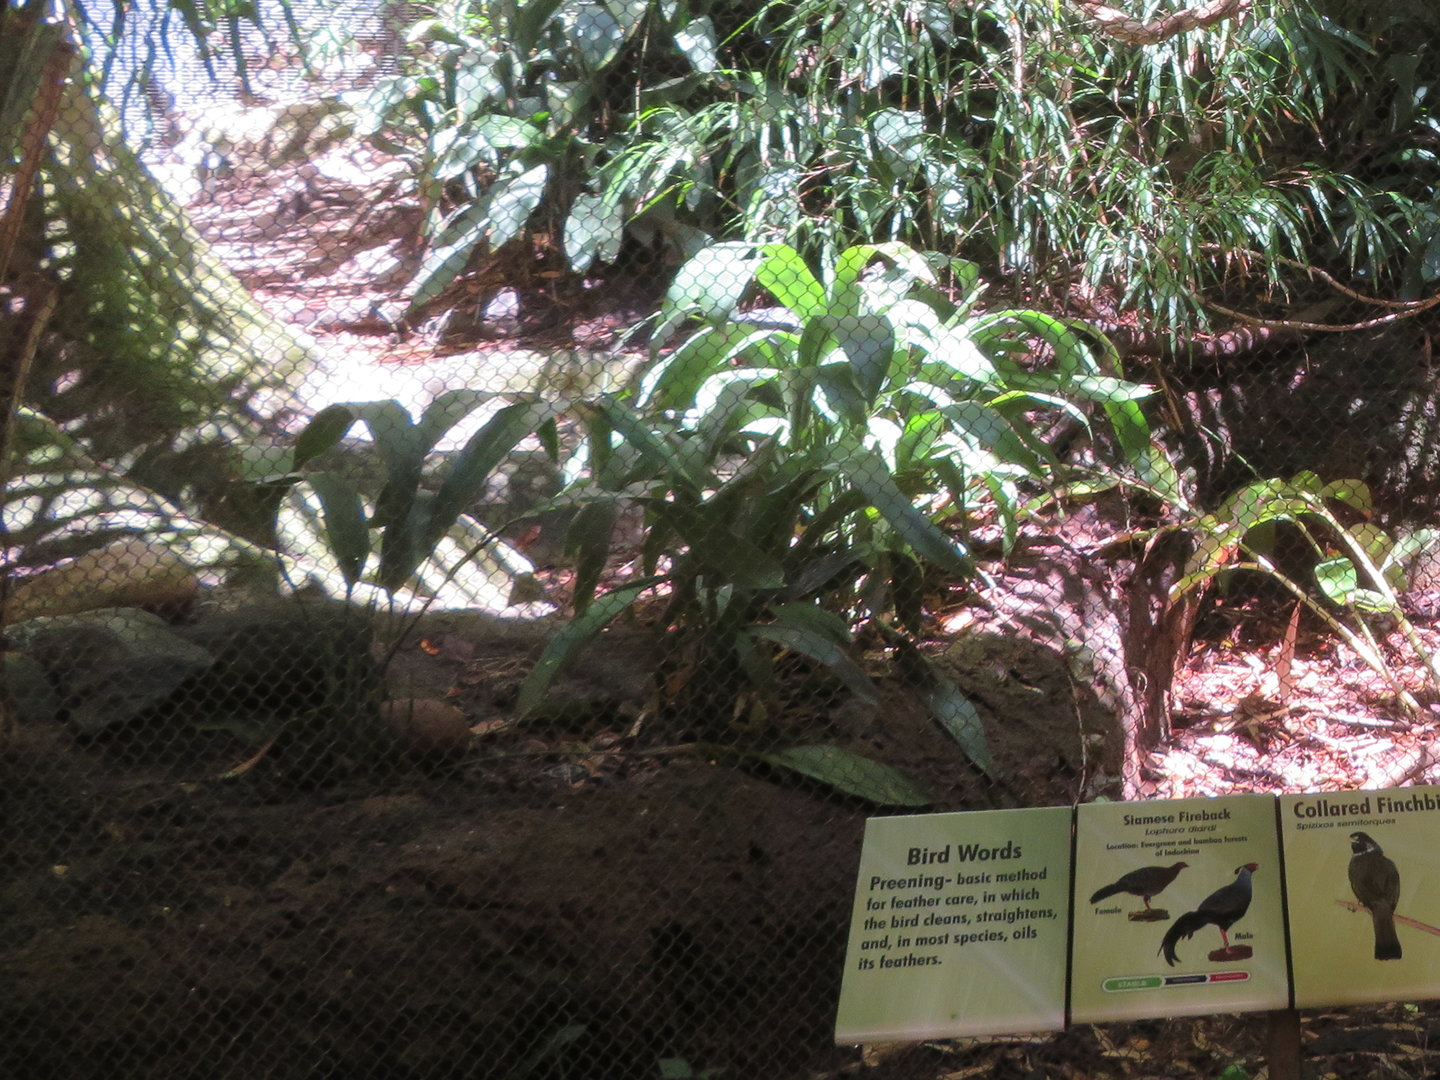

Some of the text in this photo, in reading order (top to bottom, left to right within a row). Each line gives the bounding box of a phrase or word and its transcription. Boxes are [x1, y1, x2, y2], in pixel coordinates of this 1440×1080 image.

[1123, 808, 1232, 826] Siamese Fireback
[1293, 796, 1371, 819] Collared
[907, 840, 1022, 866] Bird Words
[870, 866, 1047, 891] Preening- basic method
[866, 887, 1040, 911] for feather care, in which
[864, 907, 1058, 930] the bird cleans, straightens,
[861, 925, 1038, 951] and, in most species, oils
[1234, 931, 1254, 940] Male
[858, 953, 942, 970] its feathers.
